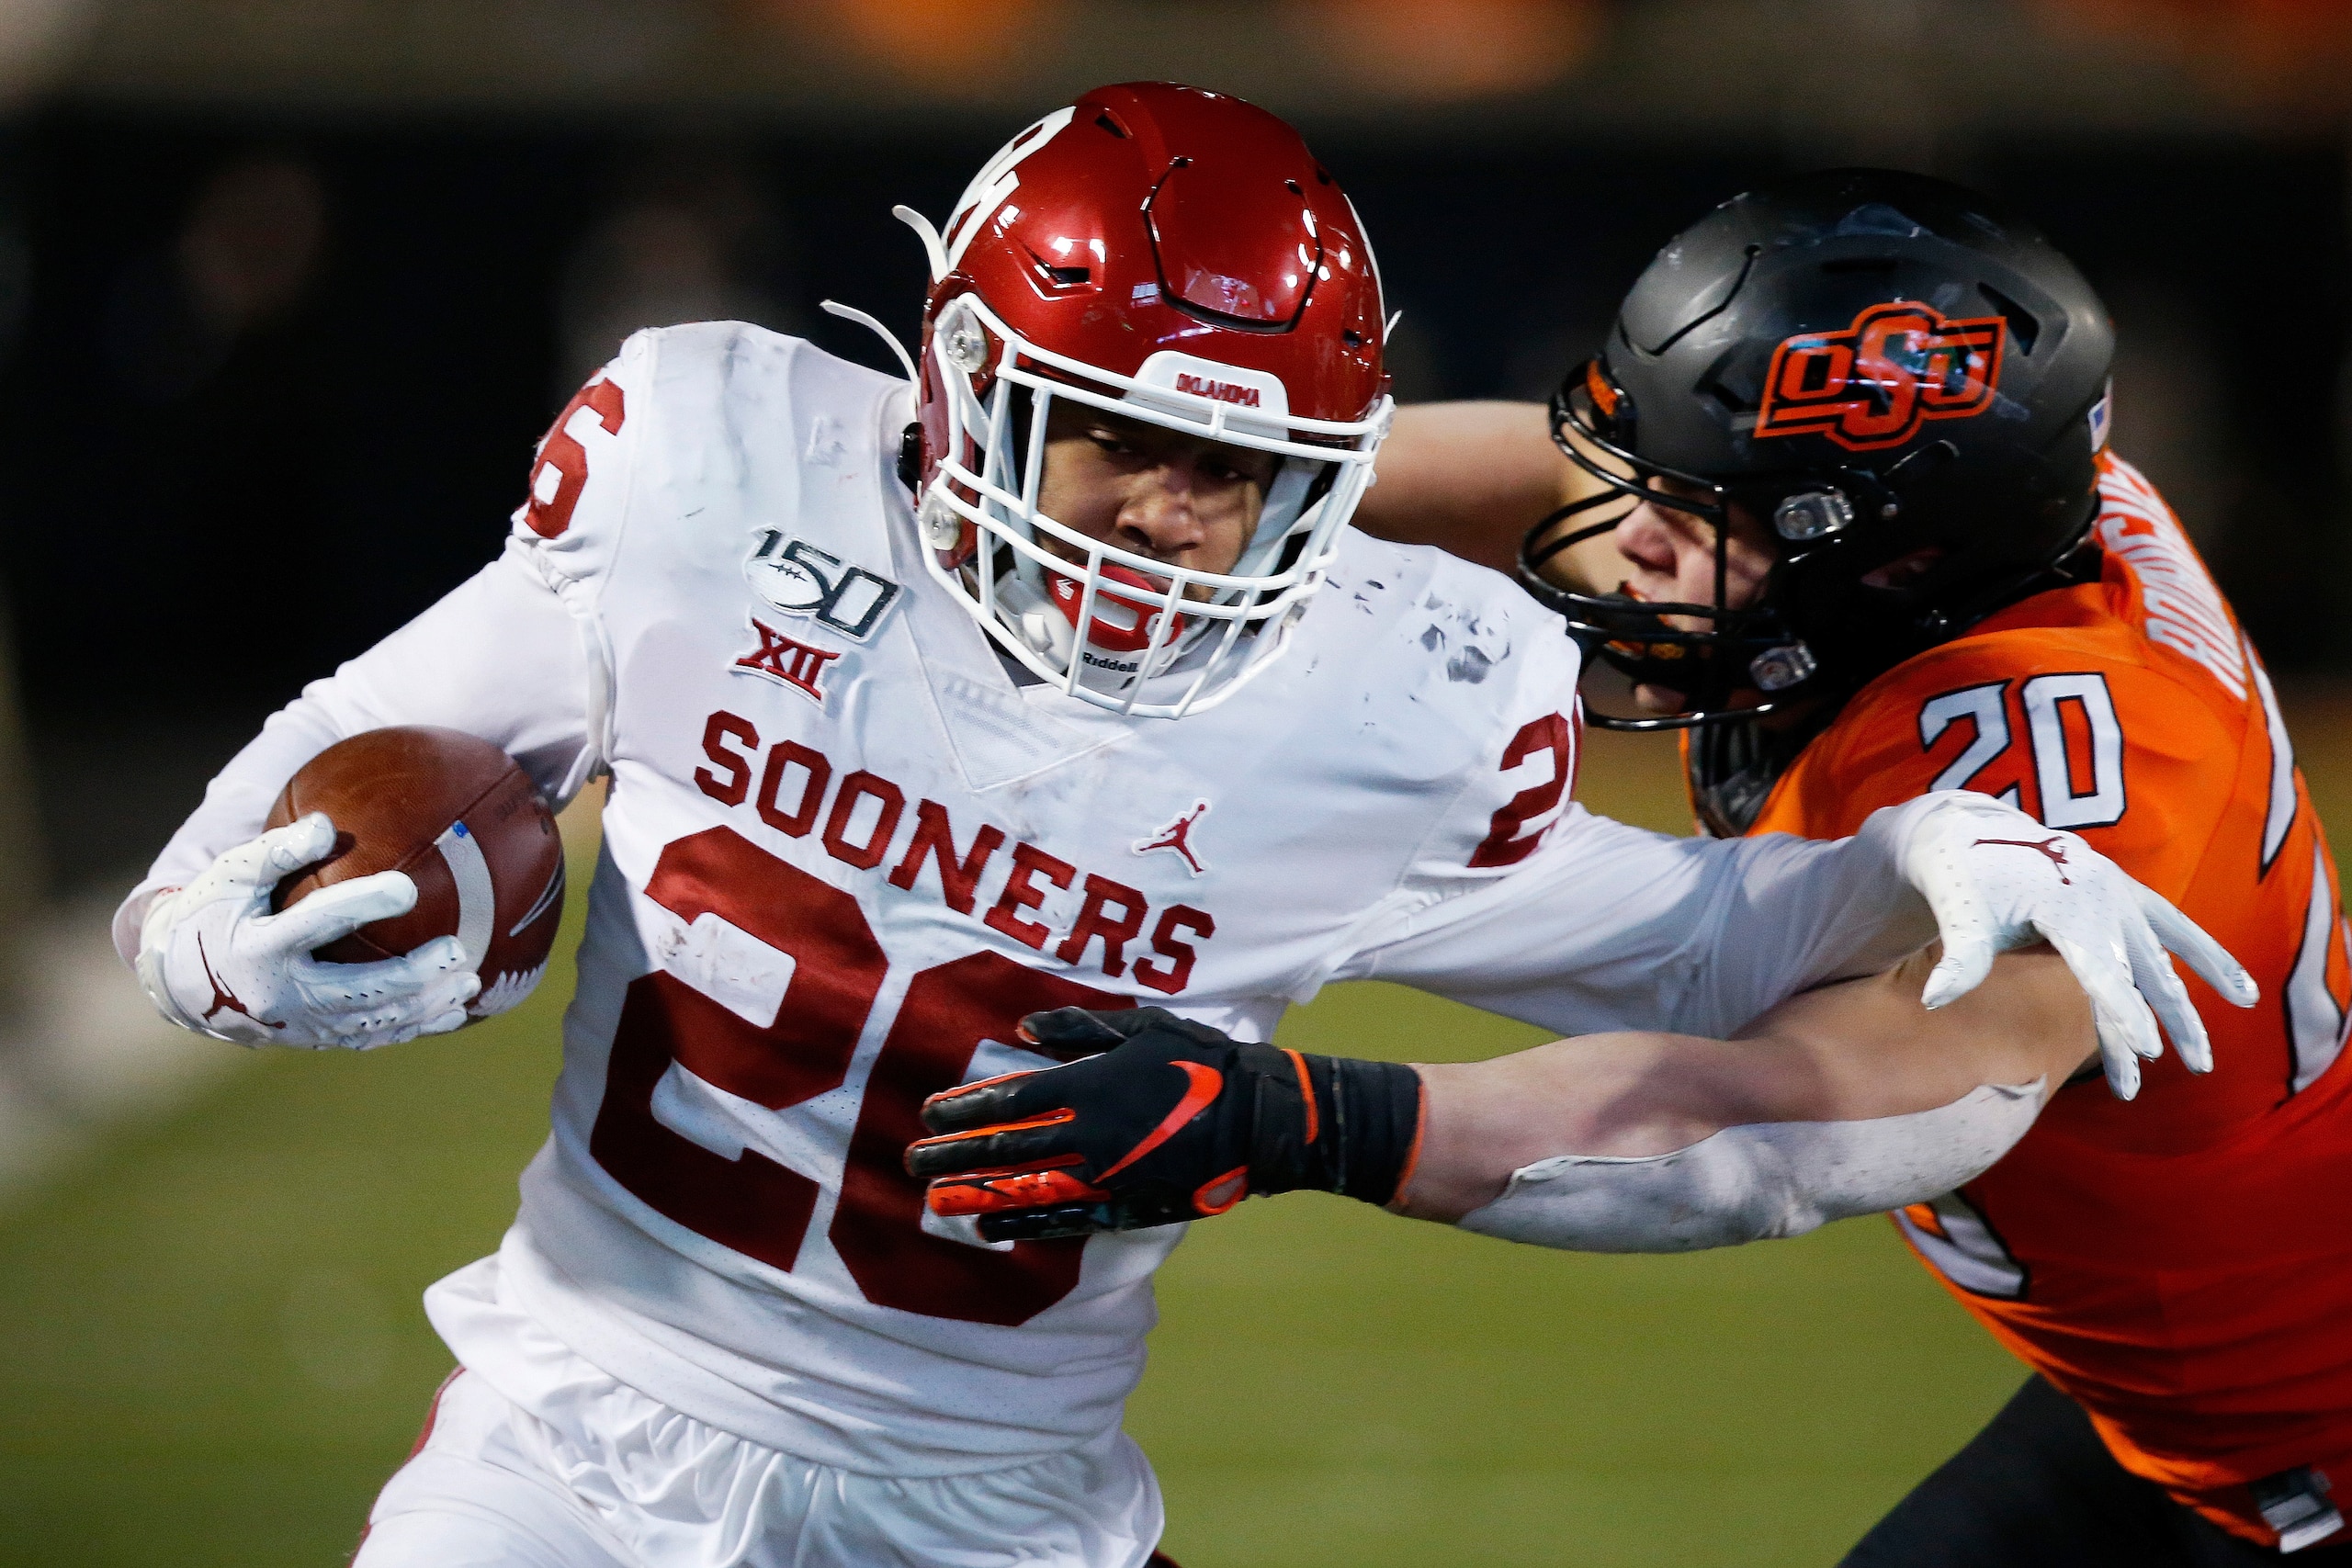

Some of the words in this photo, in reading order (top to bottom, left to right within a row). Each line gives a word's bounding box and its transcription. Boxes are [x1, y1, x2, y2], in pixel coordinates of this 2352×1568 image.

[1176, 372, 1261, 408] OKLAHOMA
[1754, 300, 2007, 451] OSU
[514, 367, 626, 539] 6
[735, 616, 841, 701] XII
[751, 526, 903, 641] 150
[1082, 651, 1139, 673] Riddell
[1466, 710, 1582, 868] 2
[1917, 671, 2128, 829] 20
[695, 710, 1216, 995] SOONERS
[590, 824, 1137, 1327] 26
